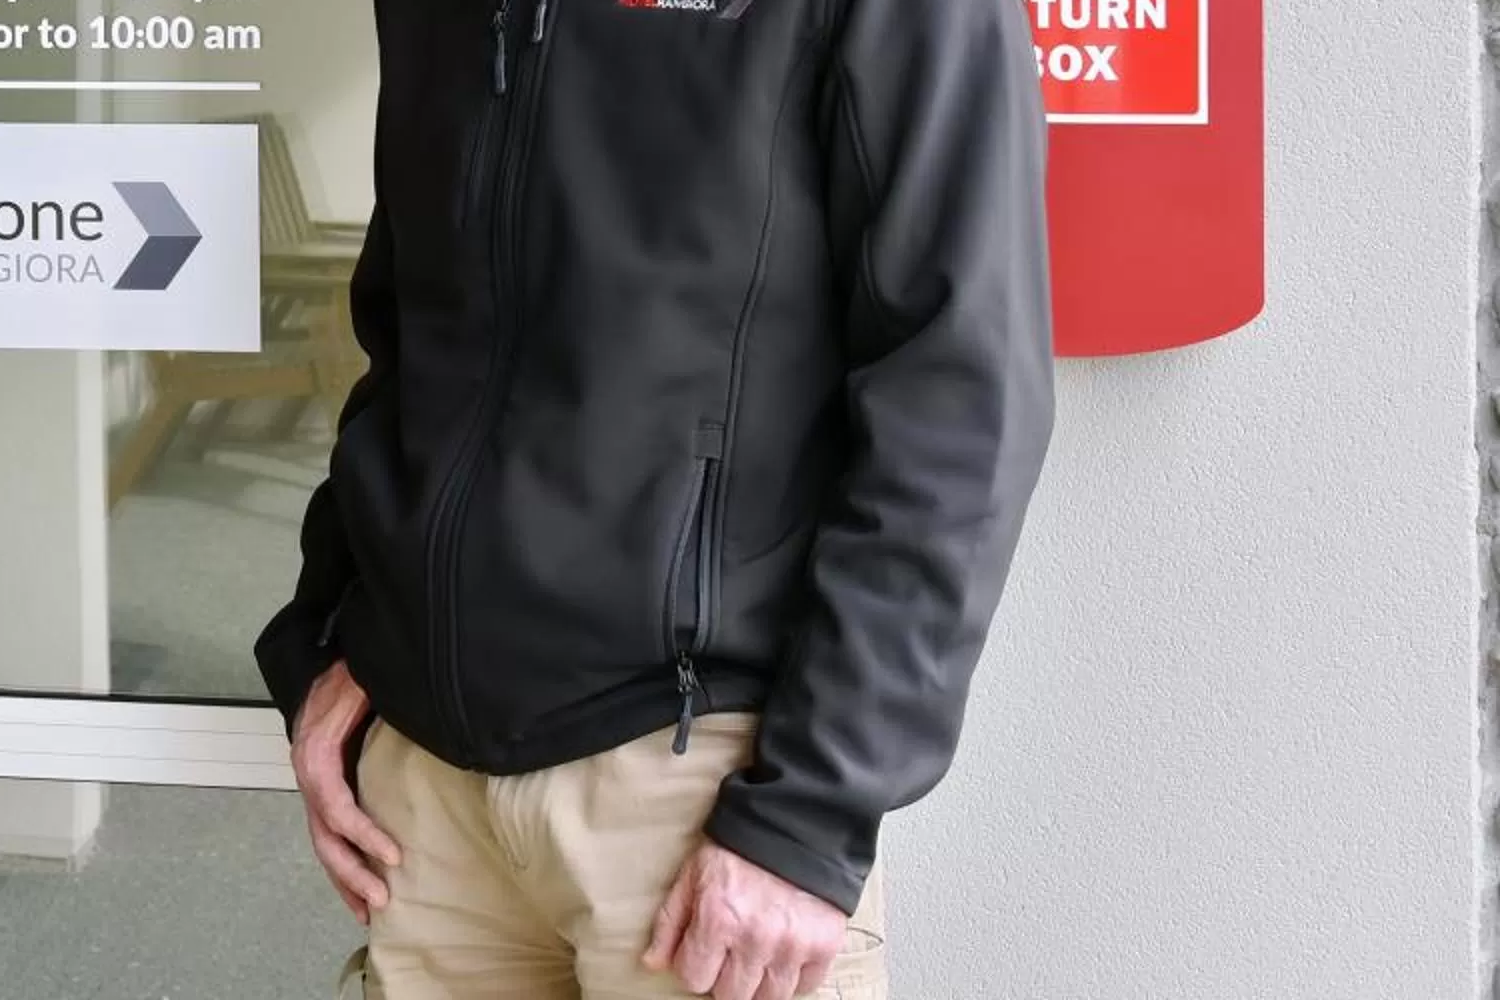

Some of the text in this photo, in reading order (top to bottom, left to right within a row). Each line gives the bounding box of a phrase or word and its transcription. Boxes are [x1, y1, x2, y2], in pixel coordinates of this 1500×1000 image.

[39, 20, 77, 49] to
[90, 15, 195, 49] 10:00
[203, 25, 262, 50] am
